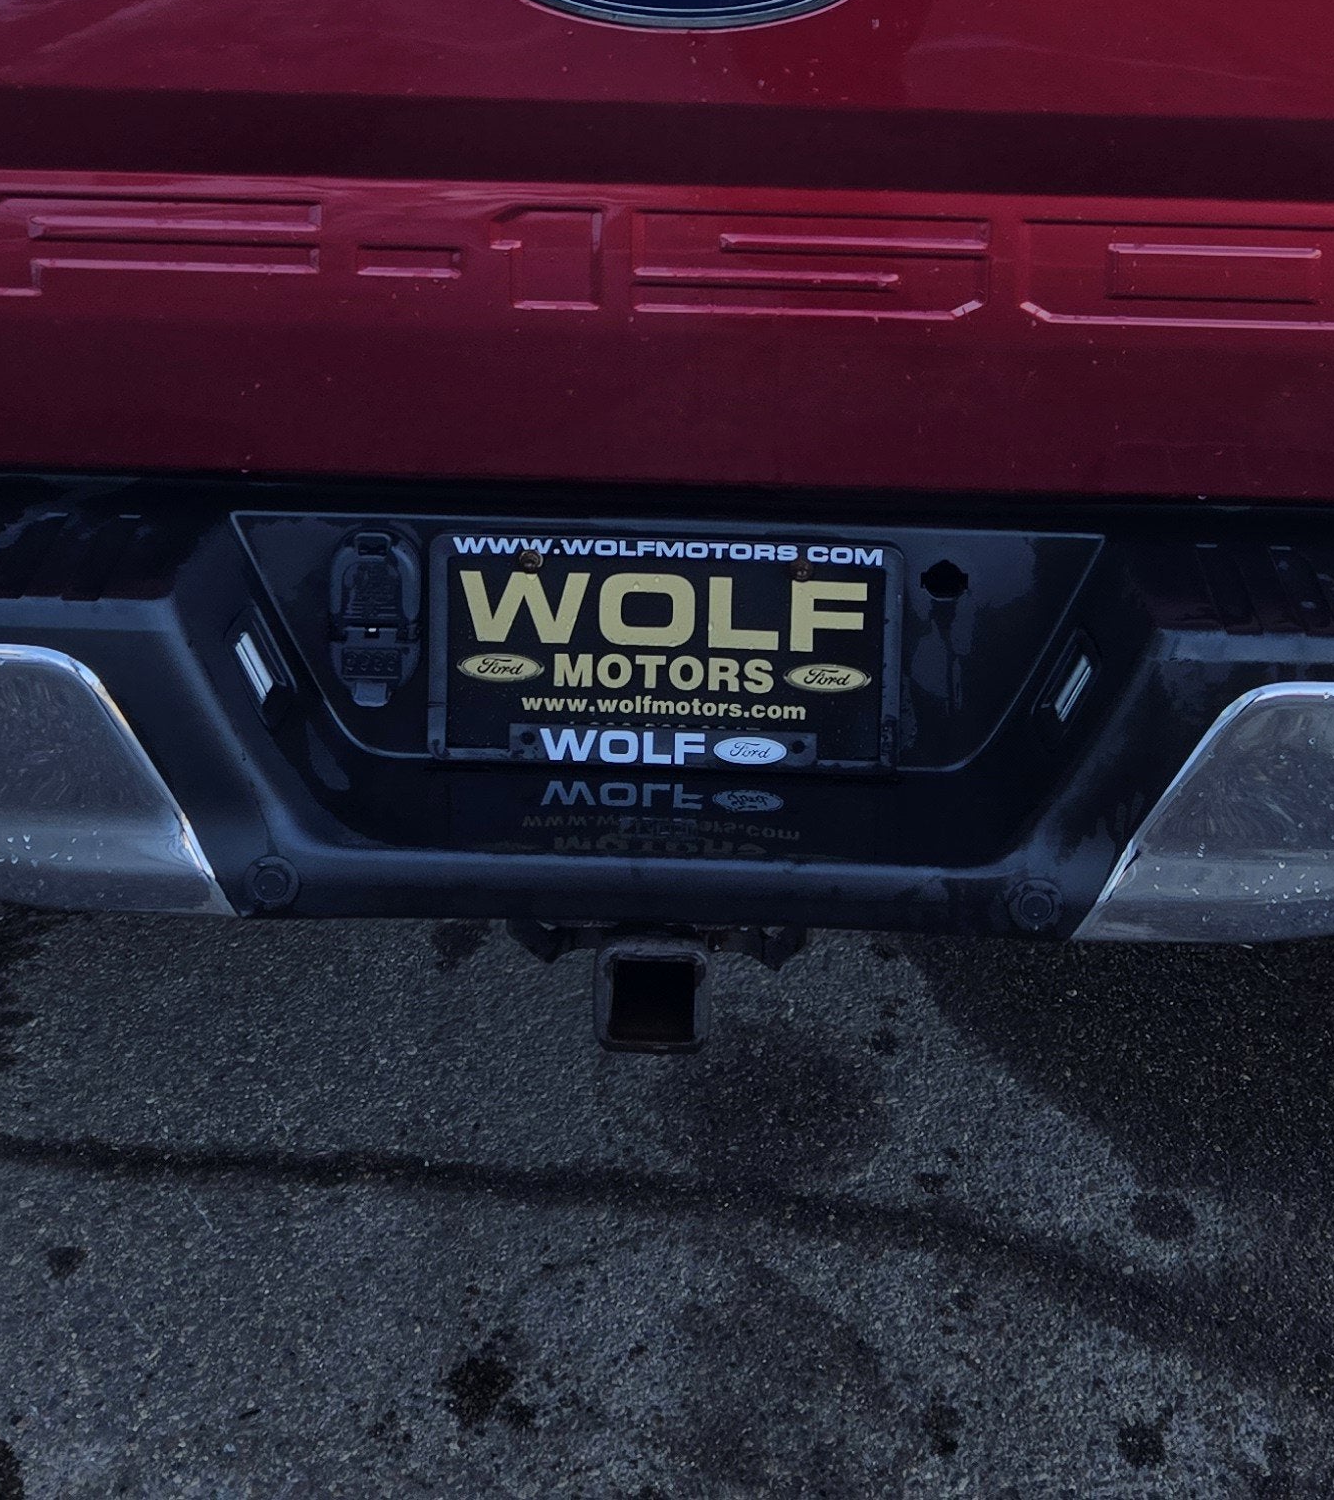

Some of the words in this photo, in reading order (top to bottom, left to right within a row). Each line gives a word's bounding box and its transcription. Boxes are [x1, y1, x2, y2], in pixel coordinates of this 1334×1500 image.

[452, 536, 884, 567] WWW.WOLFMOTORSCOM
[459, 570, 868, 653] WOLF
[477, 658, 525, 676] Ford
[553, 652, 775, 694] MOTORS
[803, 668, 852, 687] Ford
[521, 695, 807, 721] www.wolfmotors.com
[539, 727, 706, 766] WOLF
[729, 741, 772, 759] Ford
